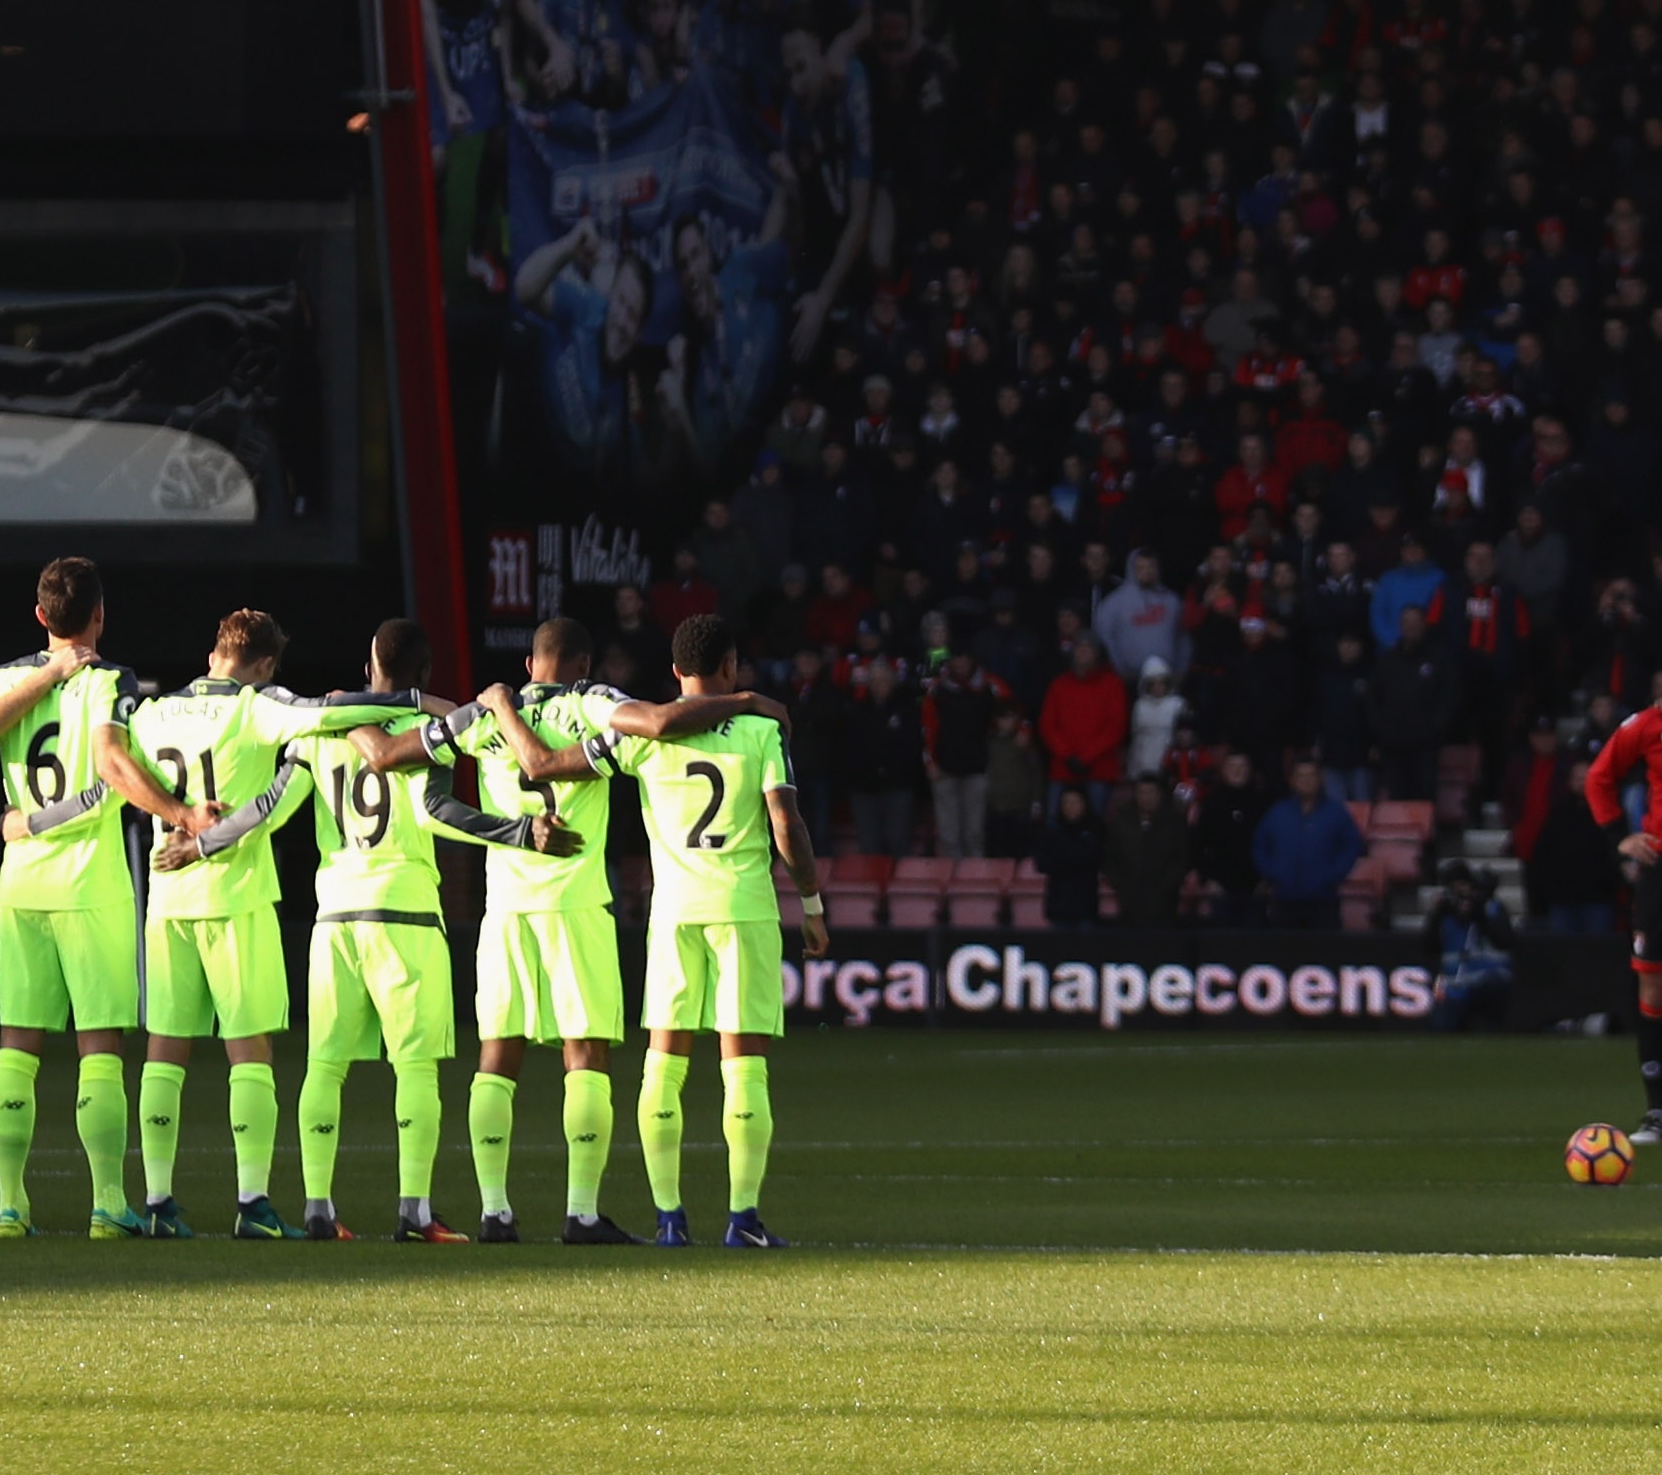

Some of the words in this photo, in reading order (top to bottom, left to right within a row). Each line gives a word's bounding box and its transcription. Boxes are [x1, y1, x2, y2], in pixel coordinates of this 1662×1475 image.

[26, 721, 66, 808] 6
[156, 747, 217, 831] 21
[332, 763, 391, 849] 19
[685, 762, 726, 849] 2
[946, 943, 1434, 1029] Chapecoens
